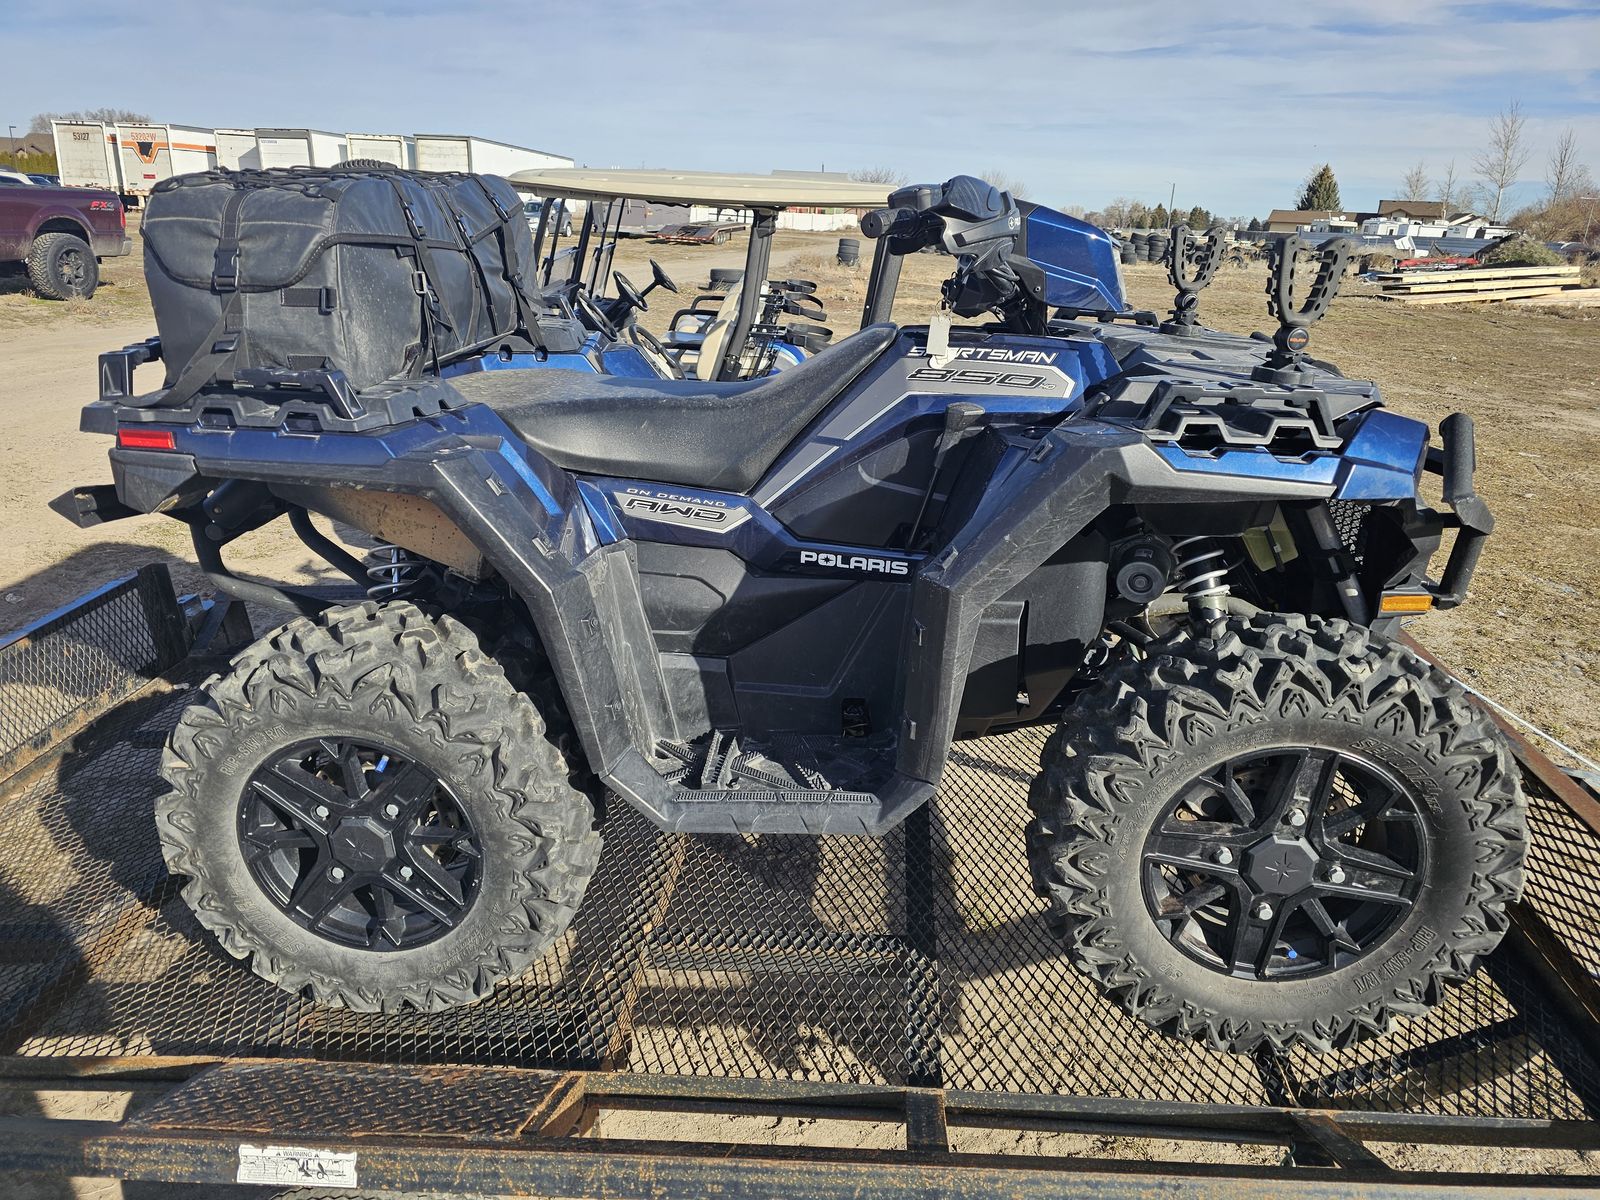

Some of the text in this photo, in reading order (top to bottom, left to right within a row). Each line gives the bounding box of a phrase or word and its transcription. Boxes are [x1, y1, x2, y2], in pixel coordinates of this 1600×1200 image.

[73, 132, 89, 140] 53127
[907, 346, 1058, 364] SRTSMAN
[906, 368, 1046, 389] 850
[626, 488, 726, 507] ON DEMAND
[625, 497, 727, 522] AWD
[800, 551, 908, 575] POLARIS
[283, 1150, 313, 1158] WARNING
